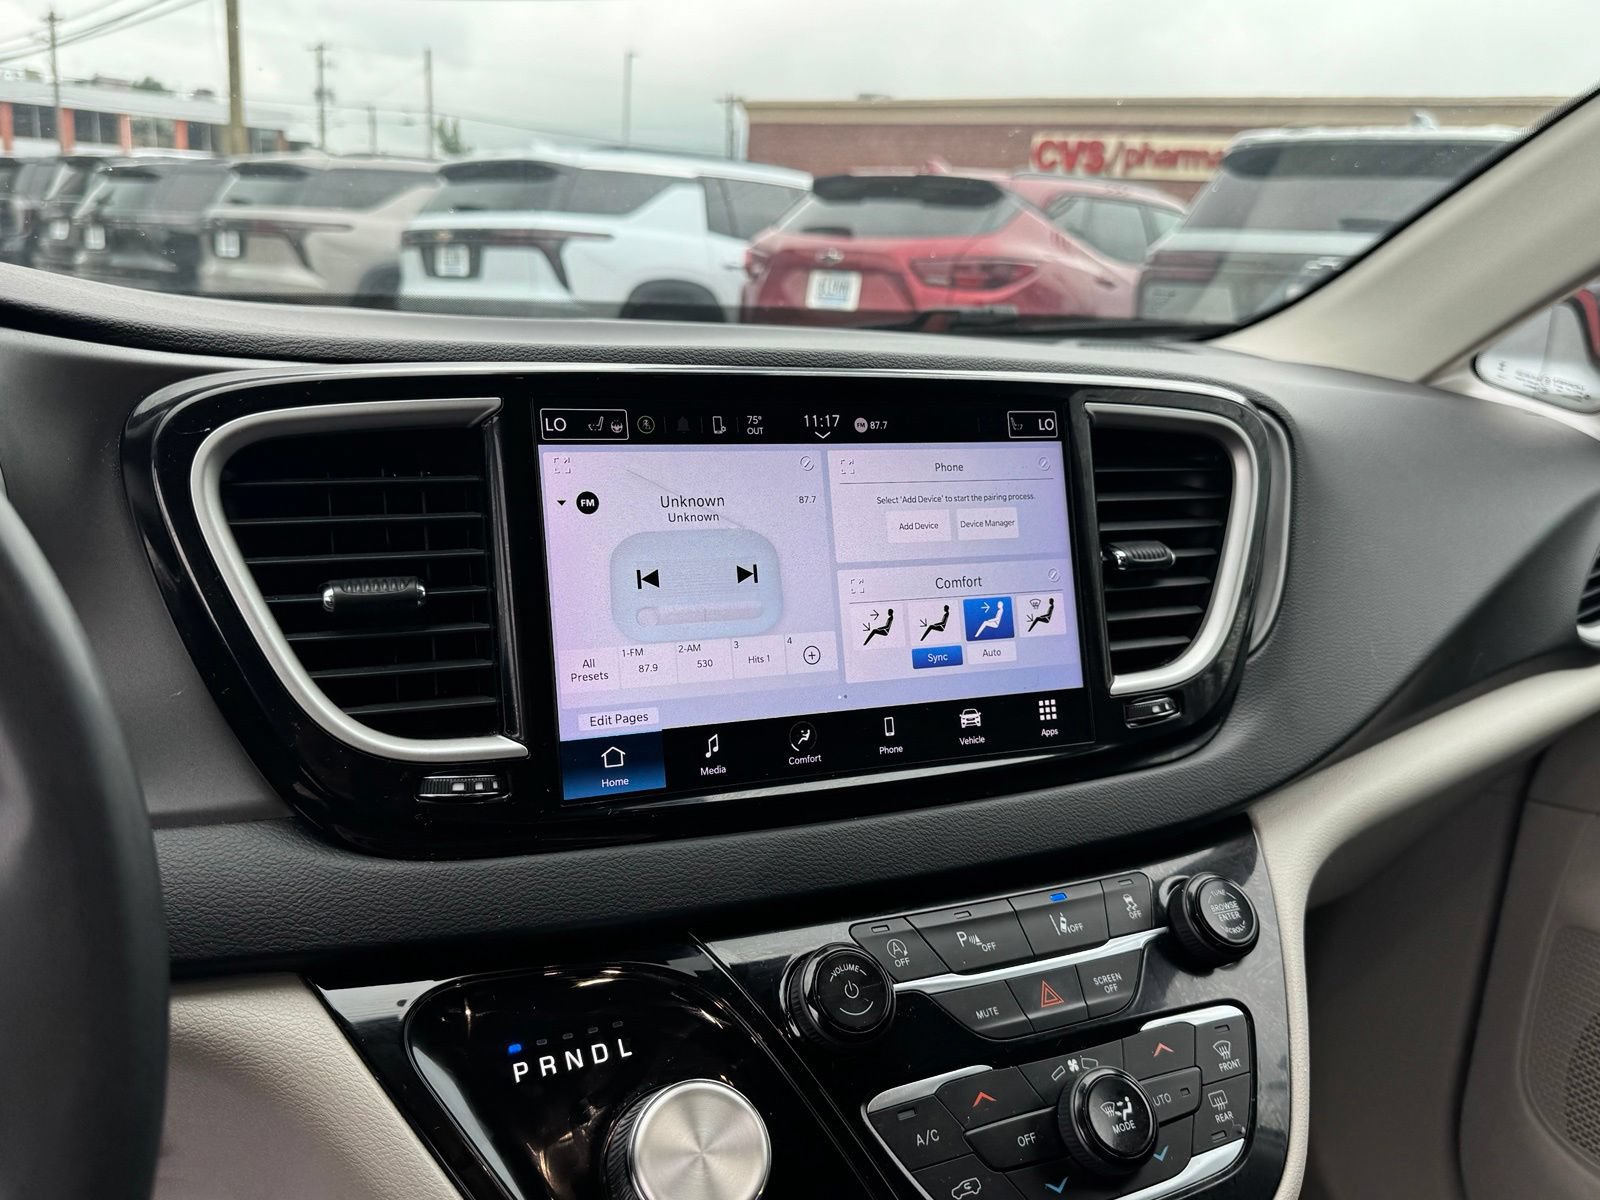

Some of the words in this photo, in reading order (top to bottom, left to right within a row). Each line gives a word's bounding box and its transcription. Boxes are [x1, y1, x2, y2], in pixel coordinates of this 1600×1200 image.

[545, 417, 567, 432] LO
[747, 415, 762, 425] 75°
[804, 414, 840, 428] 11:17
[870, 420, 888, 430] 87.7
[1038, 418, 1055, 431] LO
[747, 427, 764, 436] OUT
[934, 462, 964, 472] Phone
[580, 499, 595, 507] FM
[660, 495, 725, 508] Unknown
[798, 495, 816, 504] 87.7
[876, 496, 899, 505] Select
[945, 495, 953, 503] to
[953, 494, 970, 502] start
[970, 493, 982, 502] the
[983, 493, 1007, 503] pairing
[667, 512, 720, 523] Unknown
[899, 522, 914, 530] Add
[914, 521, 939, 530] Device
[960, 520, 984, 528] Device
[984, 519, 1015, 528] Manager
[935, 575, 983, 590] Comfort
[733, 640, 739, 649] 3
[787, 637, 793, 645] 4
[621, 648, 645, 657] 1-FM
[678, 644, 702, 654] 2-AM
[982, 649, 1002, 657] Auto
[748, 655, 765, 664] Hits
[927, 652, 949, 663] Sync
[582, 658, 596, 669] All
[638, 663, 659, 673] 87.9
[697, 659, 713, 668] 530
[570, 671, 609, 682] Presets
[590, 714, 612, 727] Edit
[615, 712, 649, 726] Pages
[1041, 727, 1059, 738] Apps
[959, 735, 985, 746] Vehicle
[879, 744, 903, 755] Phone
[788, 754, 822, 766] Comfort
[700, 765, 727, 776] Media
[601, 777, 629, 788] Home
[1210, 900, 1239, 912] BROWSE
[1128, 909, 1142, 920] OFF
[1217, 911, 1241, 922] ENTER
[1071, 922, 1084, 934] OFF
[956, 931, 968, 947] P
[981, 942, 997, 953] OFF
[894, 957, 911, 968] OFF
[831, 963, 860, 978] VOLUME
[1092, 972, 1123, 987] SCREEN
[1103, 984, 1118, 994] OFF
[975, 1006, 1000, 1020] MUTE
[1218, 1060, 1242, 1073] FRONT
[1152, 1092, 1172, 1107] UTO
[1214, 1110, 1235, 1124] REAR
[1111, 1119, 1137, 1134] MODE
[916, 1129, 940, 1147] A/C
[1016, 1131, 1037, 1148] OFF
